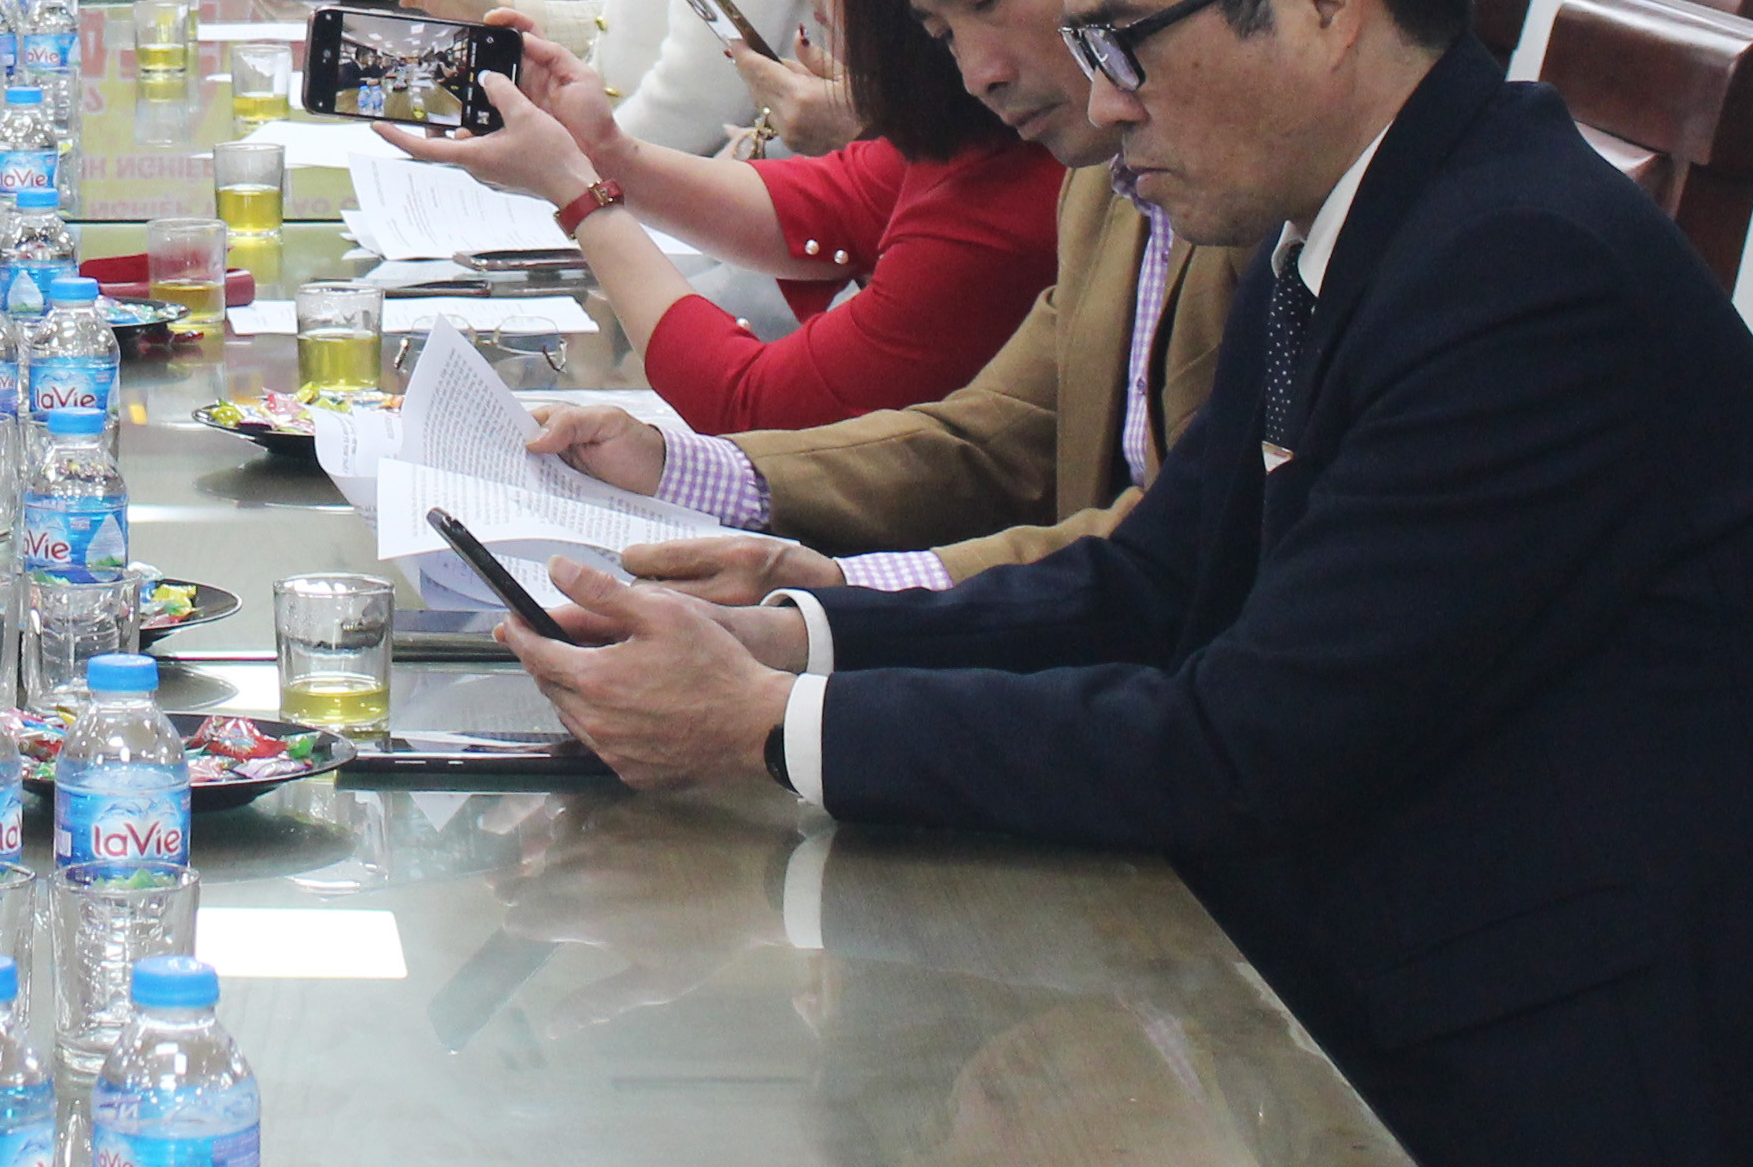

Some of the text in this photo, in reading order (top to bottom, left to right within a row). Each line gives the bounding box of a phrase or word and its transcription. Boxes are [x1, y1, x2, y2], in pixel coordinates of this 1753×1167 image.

[0, 168, 47, 187] laVie
[36, 386, 95, 410] laVie
[94, 821, 181, 857] laVie
